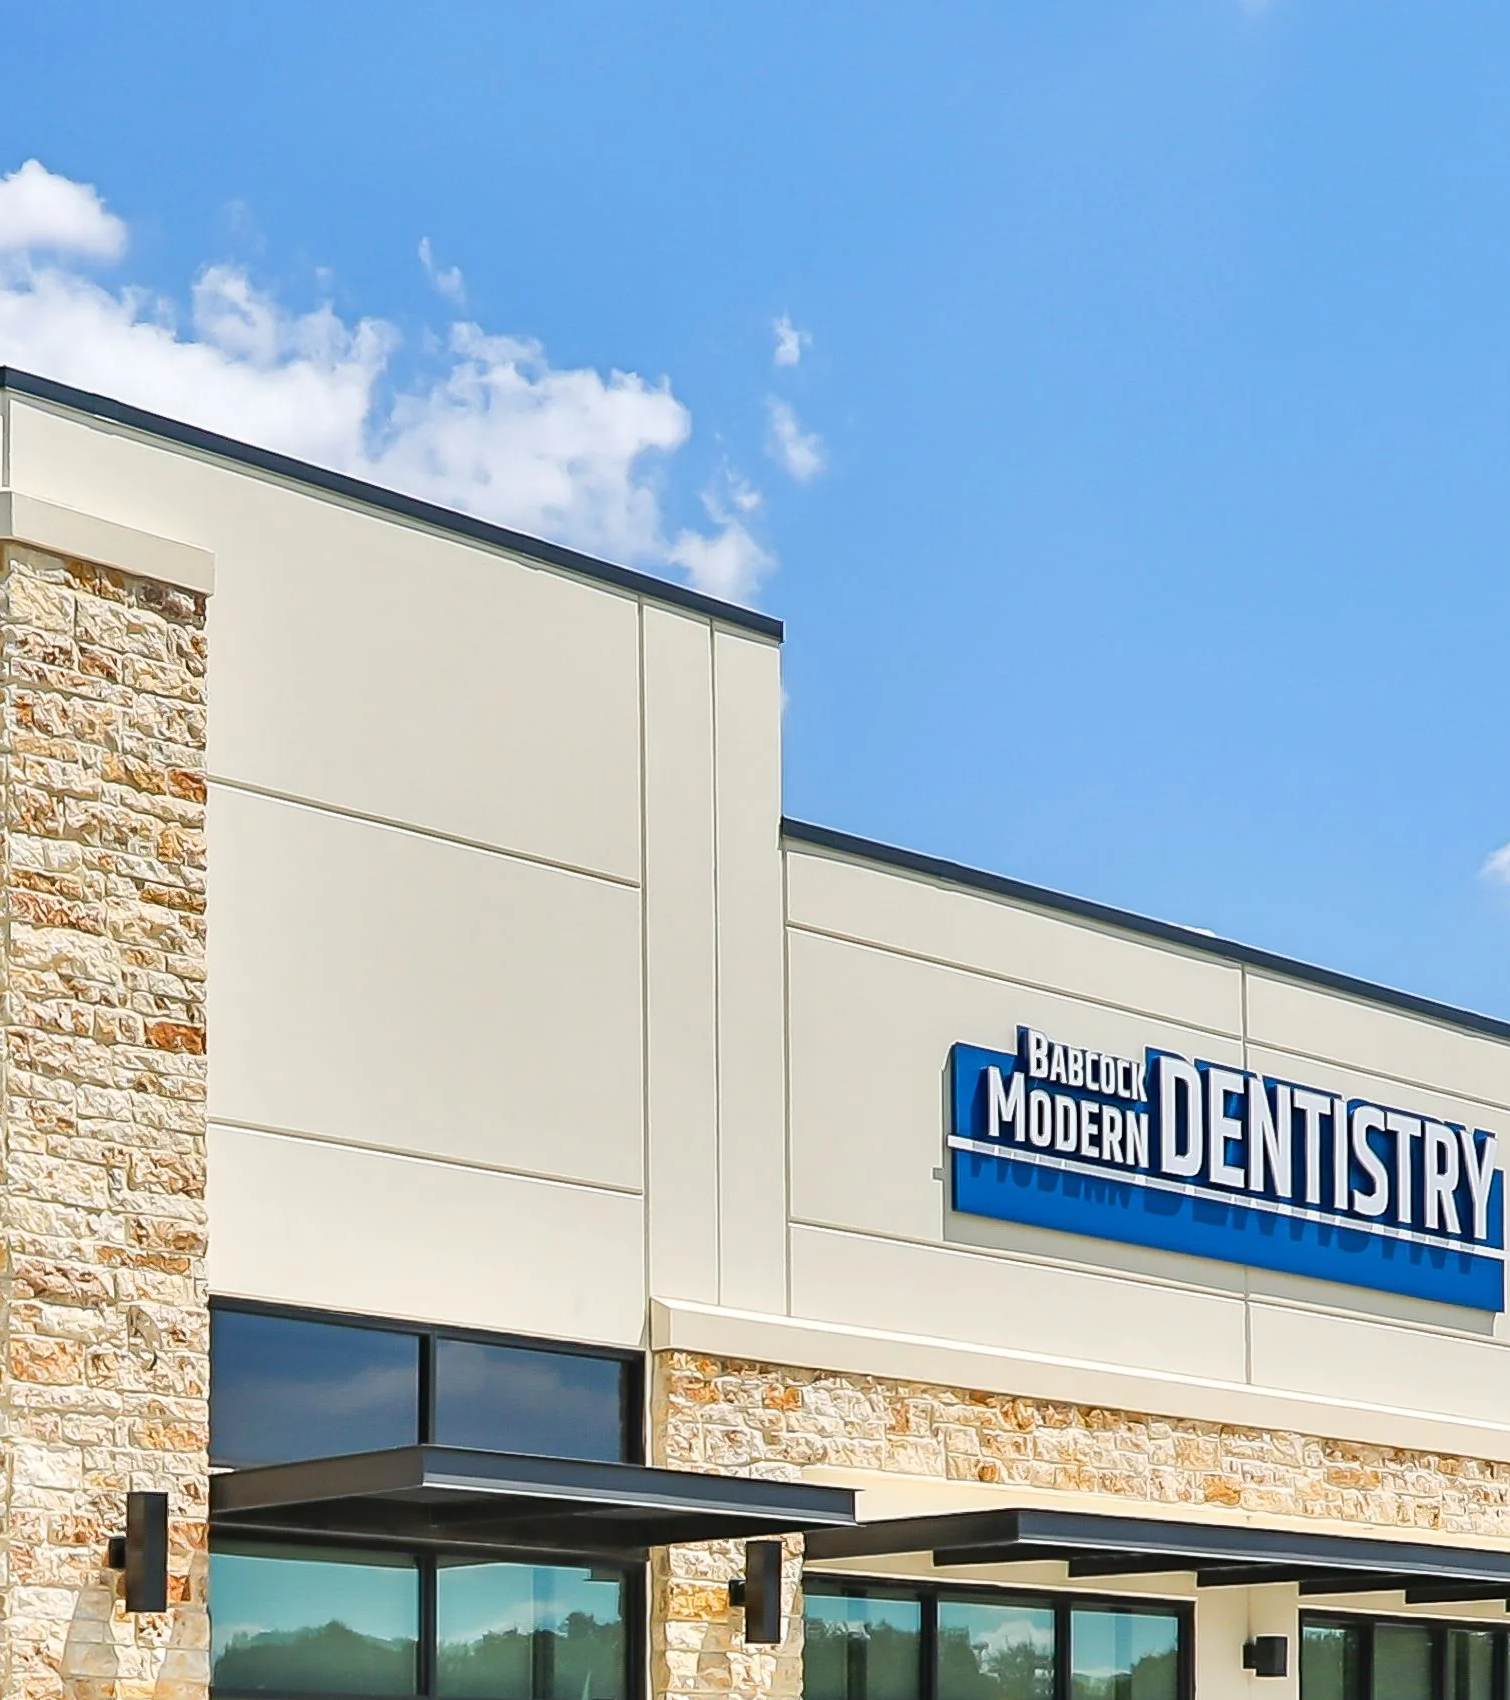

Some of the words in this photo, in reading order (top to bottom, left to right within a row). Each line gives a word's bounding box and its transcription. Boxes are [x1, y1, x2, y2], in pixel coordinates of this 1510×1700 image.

[1028, 1028, 1148, 1103] BABCOCK
[988, 1065, 1150, 1169] MODERN
[1159, 1055, 1499, 1240] DENTISTRY
